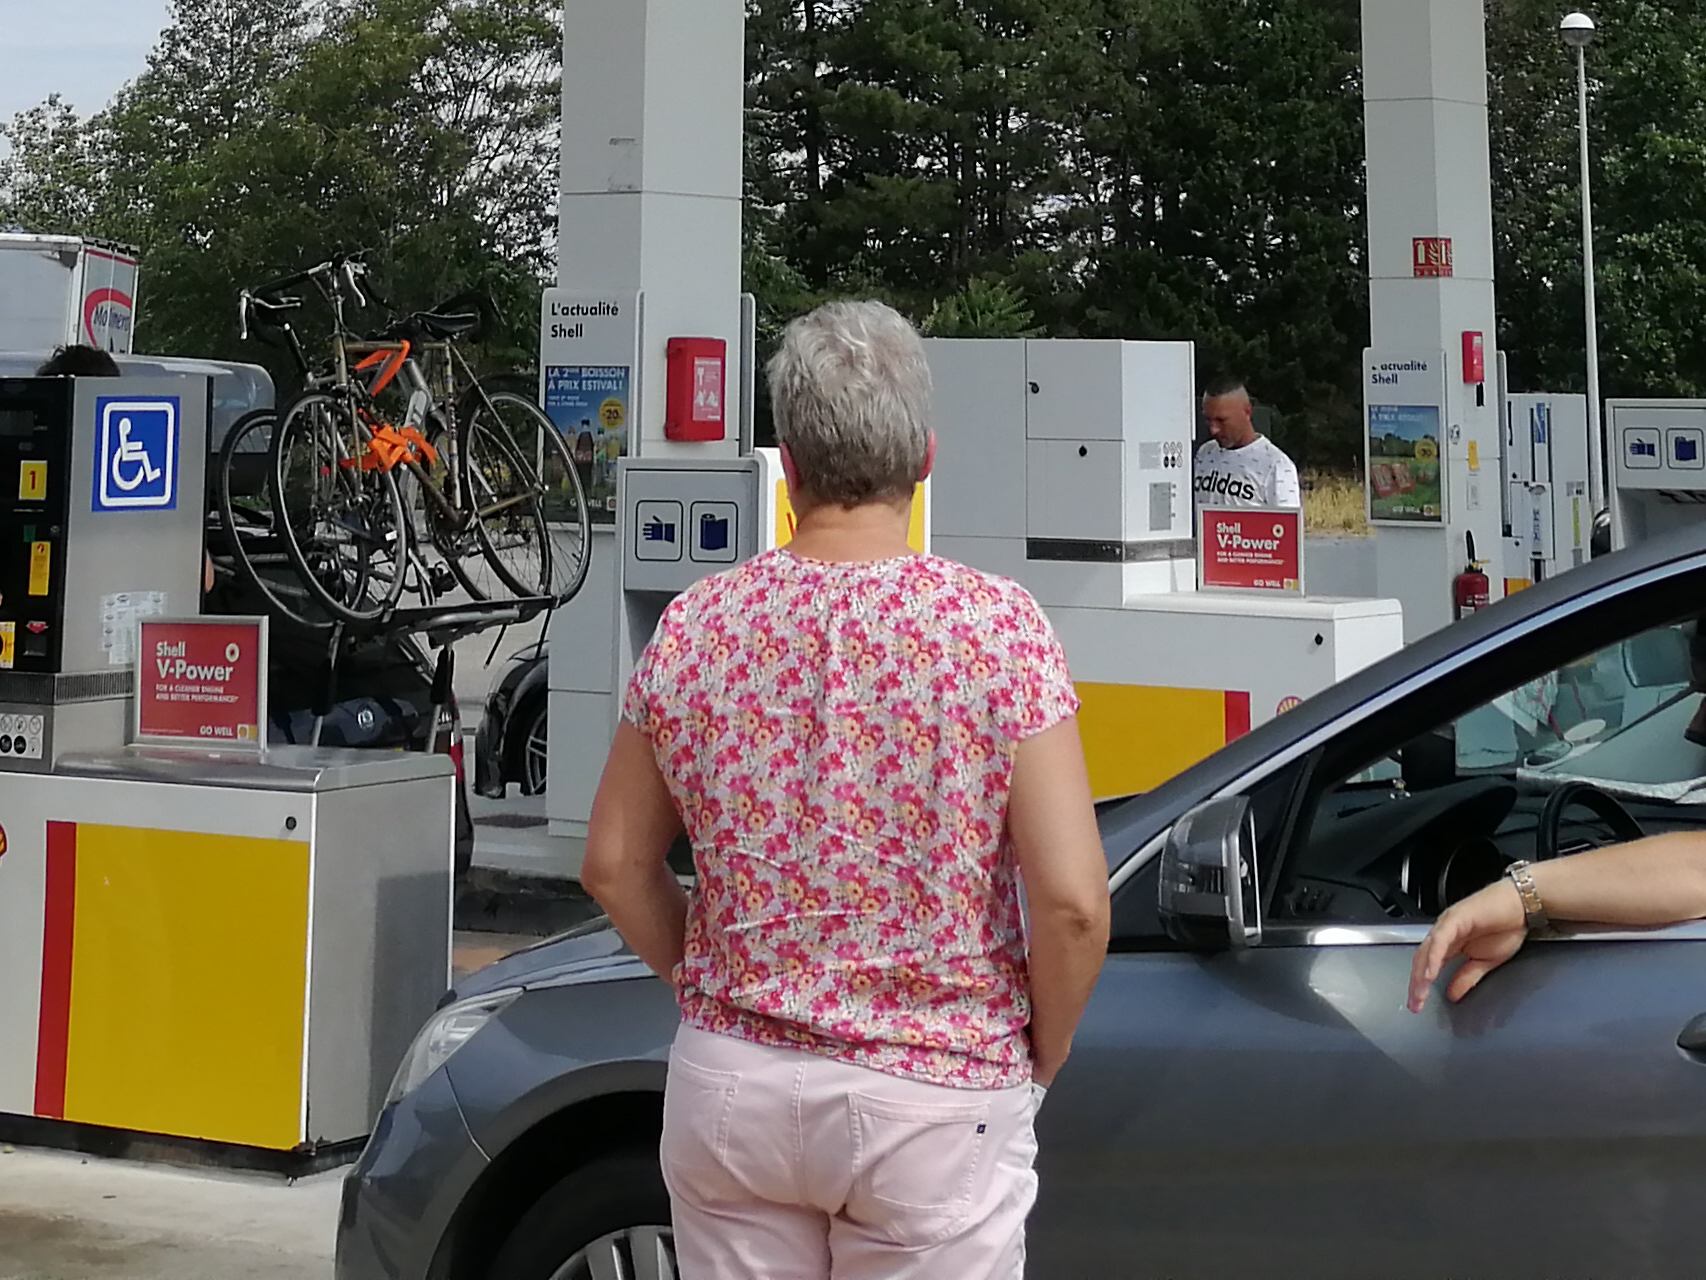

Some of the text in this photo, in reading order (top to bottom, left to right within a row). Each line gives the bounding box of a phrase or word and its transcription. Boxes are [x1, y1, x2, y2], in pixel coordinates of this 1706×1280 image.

[550, 301, 620, 317] L'actualité
[550, 324, 584, 338] Shell
[558, 380, 580, 390] PRIX
[1371, 373, 1399, 385] Shell
[29, 470, 37, 491] 1
[1194, 469, 1255, 501] adidas
[1216, 522, 1241, 534] Shell
[1216, 534, 1280, 551] V-Power
[156, 641, 186, 657] Shell
[156, 658, 234, 681] V-Power
[199, 725, 234, 737] GO WELL
